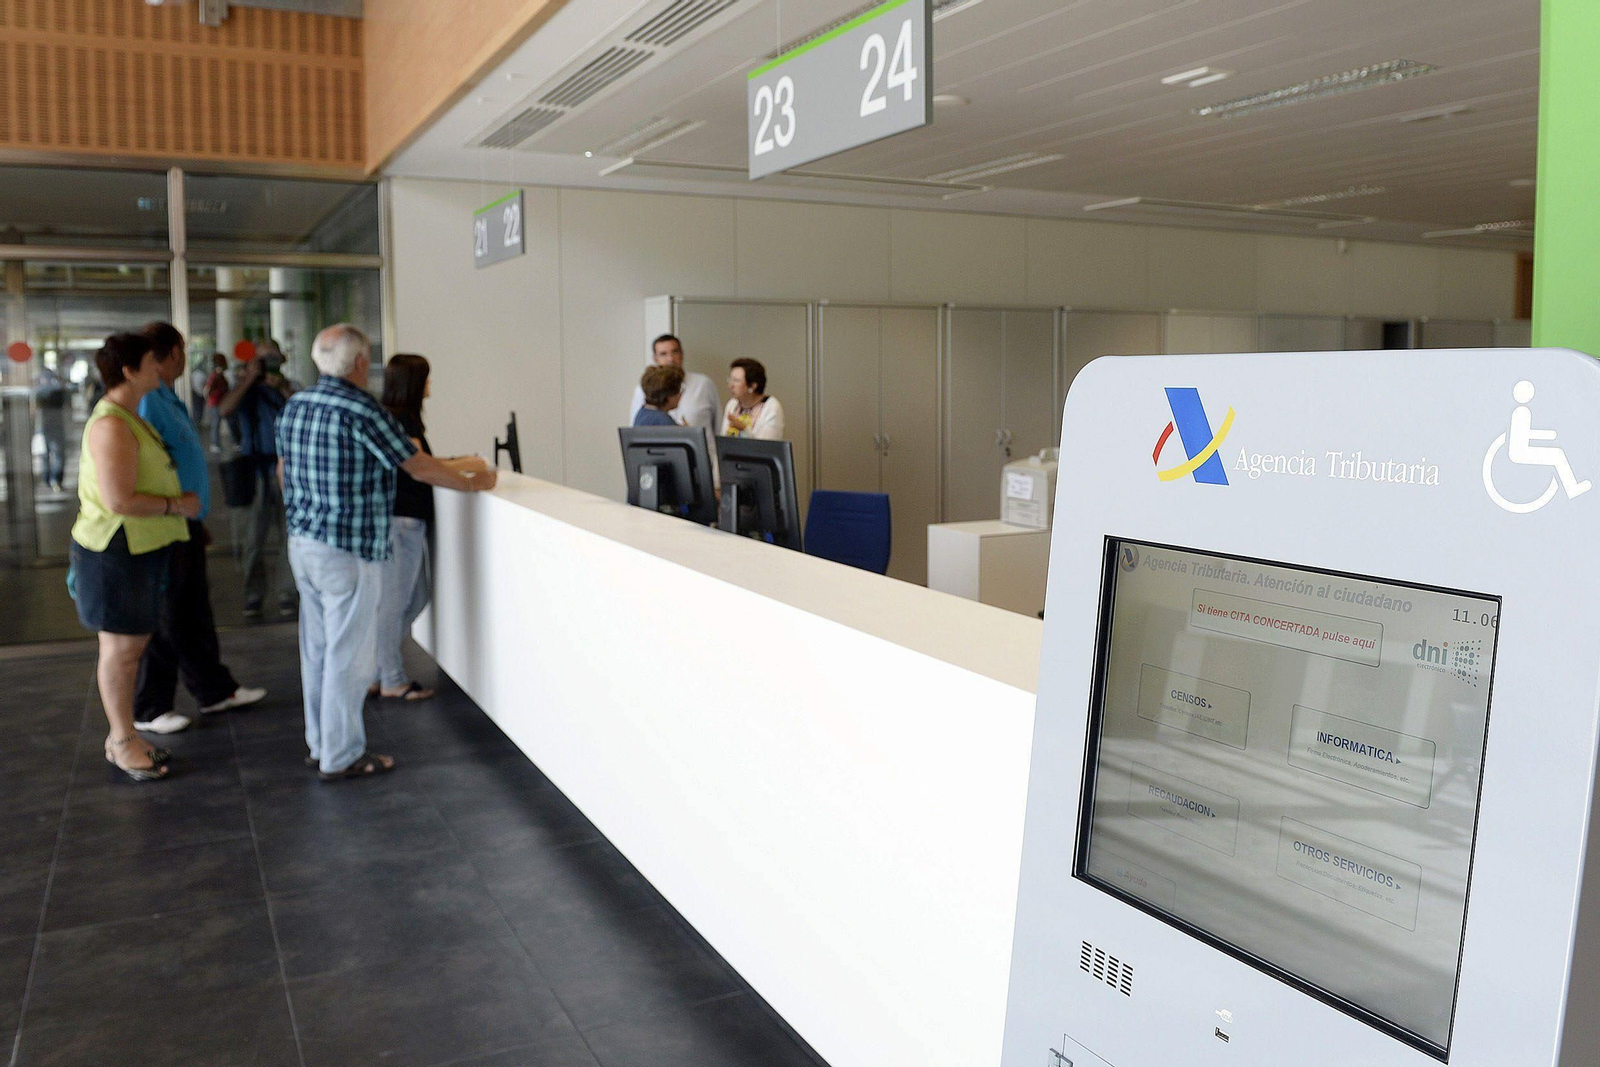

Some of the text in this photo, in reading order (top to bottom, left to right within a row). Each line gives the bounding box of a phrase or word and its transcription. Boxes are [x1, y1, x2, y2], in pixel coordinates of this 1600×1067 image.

[753, 18, 917, 156] 23 24
[474, 203, 520, 257] 21 22
[1233, 446, 1440, 486] Agencia Tributaria
[1143, 554, 1413, 613] Agencia Tributaria. Atención al ciudadano
[1197, 603, 1206, 613] Si
[1207, 606, 1228, 618] tiene
[1230, 610, 1250, 623] CITA
[1252, 615, 1320, 637] CONCERTADA
[1321, 630, 1350, 644] pulse
[1413, 639, 1448, 665] dni
[1171, 689, 1207, 708] CENSOS
[1306, 747, 1321, 756] Firma
[1316, 731, 1394, 763] INFORMATICA
[1148, 784, 1211, 817] RECAUDACION
[1123, 871, 1148, 888] Ayuda
[1293, 840, 1393, 888] OTROS SERVICIOS
